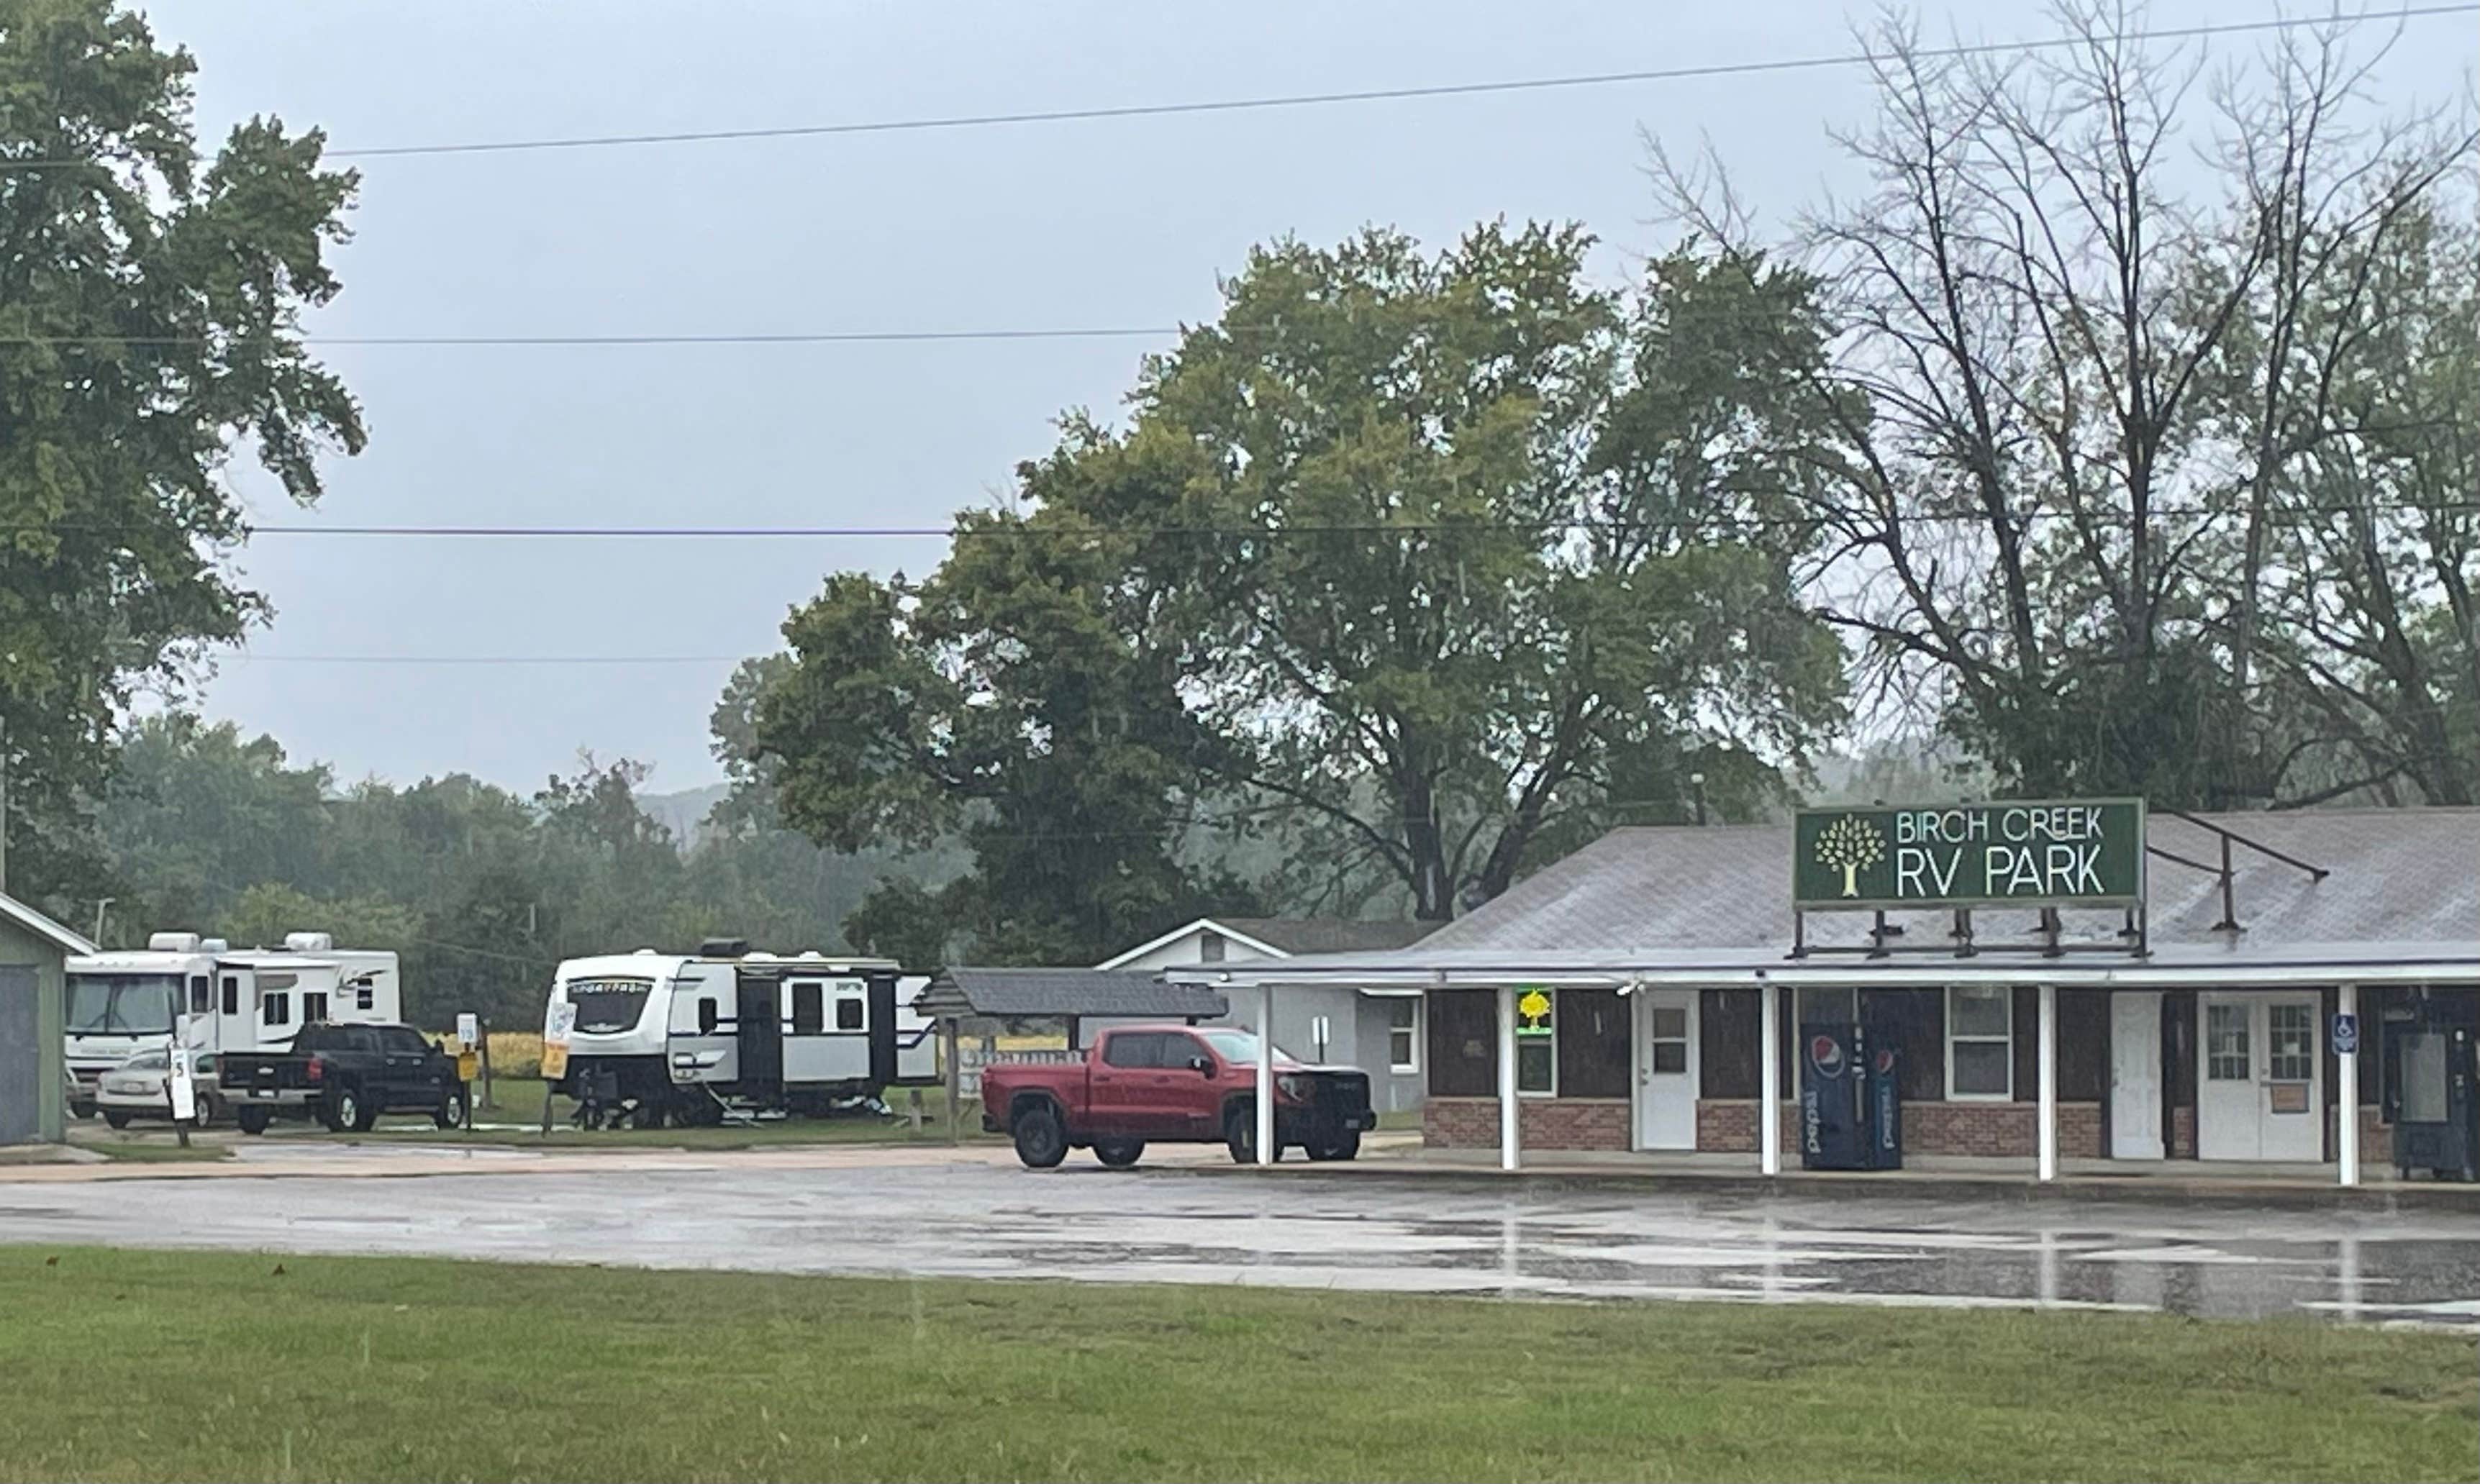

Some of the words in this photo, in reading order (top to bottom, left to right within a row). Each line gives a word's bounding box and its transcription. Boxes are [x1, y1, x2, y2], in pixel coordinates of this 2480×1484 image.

[1897, 810, 1989, 843] BIRCH
[2002, 807, 2104, 842] CREEK
[1897, 847, 1963, 897] RV
[1986, 844, 2105, 895] PARK
